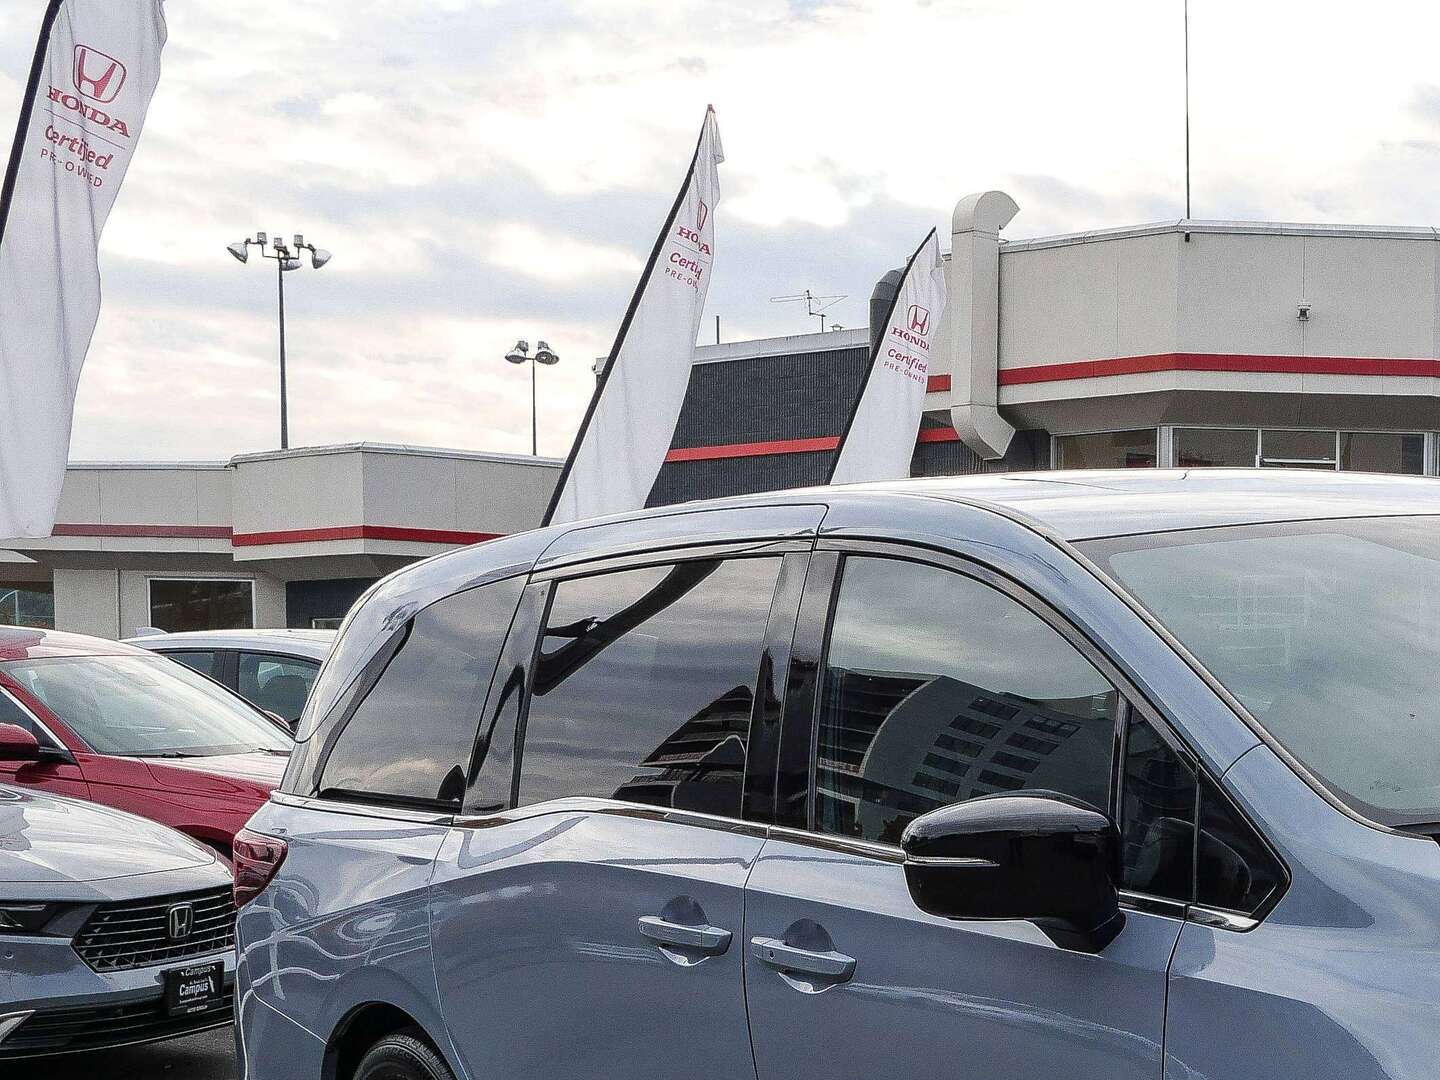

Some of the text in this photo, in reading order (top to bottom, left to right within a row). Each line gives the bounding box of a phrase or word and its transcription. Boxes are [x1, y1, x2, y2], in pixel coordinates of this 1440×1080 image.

[47, 86, 130, 138] HONDA
[677, 226, 711, 256] HOA
[888, 349, 928, 373] Certified
[186, 966, 211, 976] Campus
[180, 982, 209, 996] Campus
